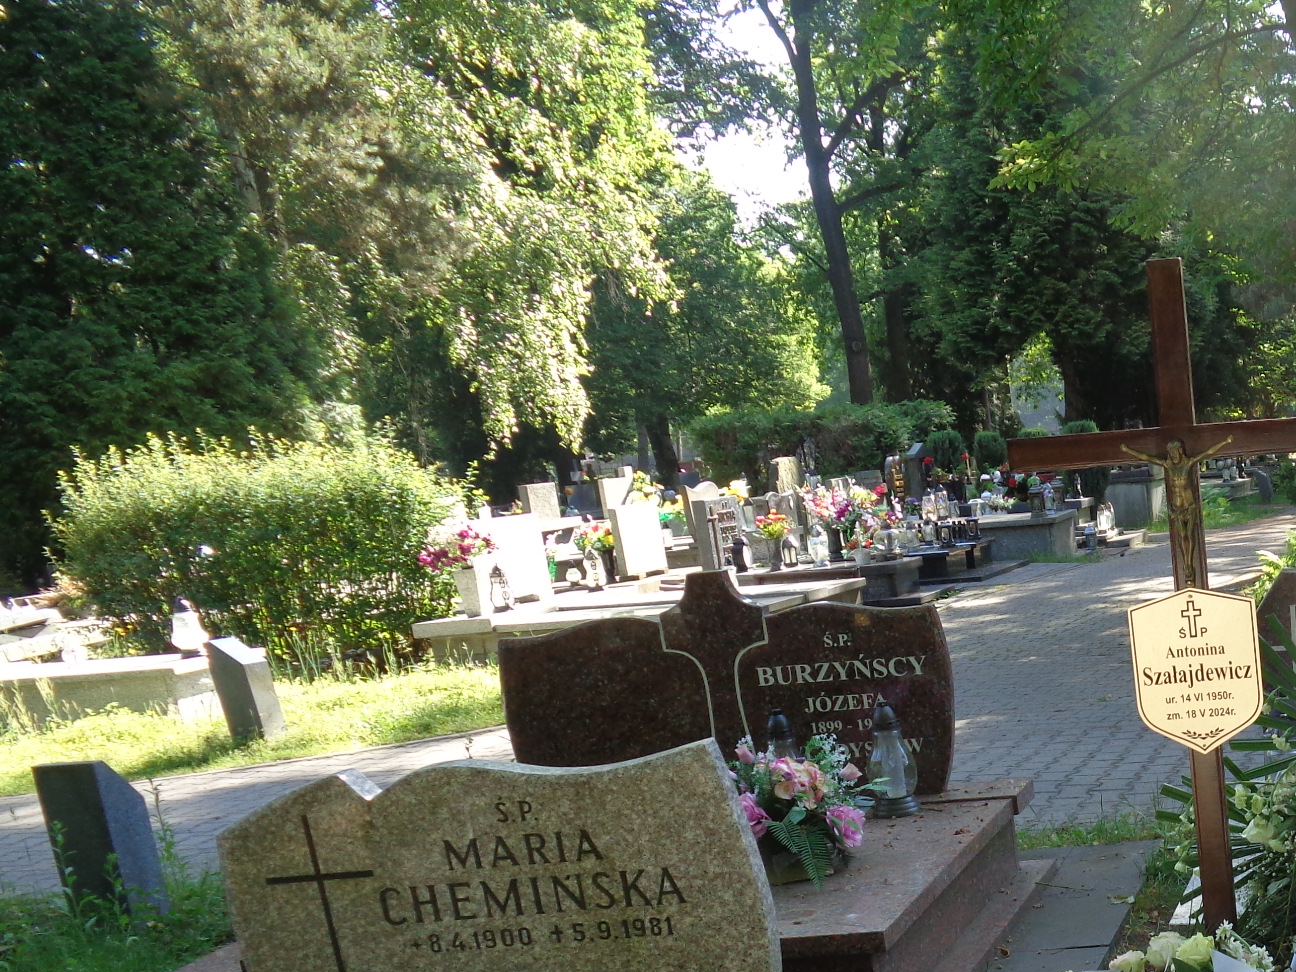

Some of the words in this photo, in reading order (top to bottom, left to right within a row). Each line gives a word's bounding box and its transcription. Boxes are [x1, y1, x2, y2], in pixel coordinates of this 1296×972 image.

[1166, 642, 1226, 659] Antonina
[755, 654, 927, 687] BURZYŃSCY
[1142, 660, 1253, 689] Szałajdewicz
[804, 692, 887, 714] JÓZEFA
[1165, 695, 1178, 704] ur.
[1180, 693, 1191, 703] 14
[1193, 692, 1204, 702] VI
[1206, 690, 1235, 701] 1950r.
[1166, 711, 1184, 720] zm.
[1185, 709, 1197, 719] 18
[1198, 708, 1206, 718] V
[1208, 706, 1237, 718] 2024r.
[810, 720, 843, 735] 1899
[442, 828, 604, 872] MARIA
[379, 866, 688, 926] CHEMIŃSKA
